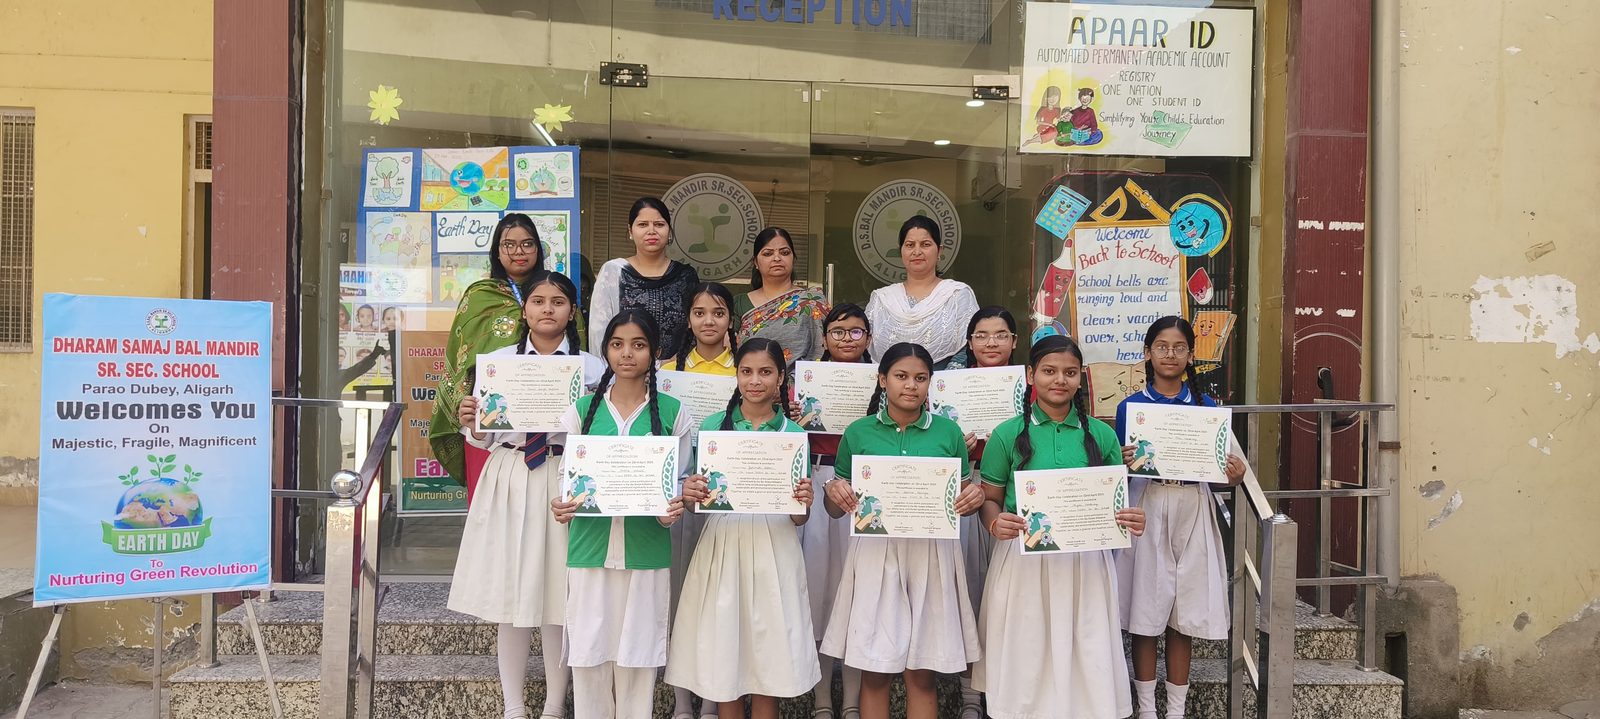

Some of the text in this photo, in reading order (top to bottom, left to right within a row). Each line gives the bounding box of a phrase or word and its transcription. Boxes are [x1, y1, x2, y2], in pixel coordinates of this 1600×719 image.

[712, 0, 912, 27] RECEPTION
[1068, 17, 1216, 48] APAAR ID
[1037, 48, 1231, 68] AUTOMATED PERMANENT ACADEMIC ACCOUNT
[1119, 70, 1156, 82] REGISTRY
[1103, 85, 1162, 96] ONE NATION
[1126, 97, 1201, 107] ONE STUDENT ID
[1099, 112, 1135, 127] Simplifying
[1189, 112, 1225, 126] Education
[1142, 128, 1177, 142] Journey
[670, 180, 708, 206] MANDIR
[869, 186, 907, 211] MANDIR
[438, 217, 494, 247] Earth Day
[1095, 227, 1153, 242] Welcome
[1078, 240, 1179, 270] Back to School
[874, 262, 907, 280] ALIG
[1078, 274, 1112, 287] School
[1116, 274, 1141, 287] bells
[1078, 291, 1168, 306] ringing loud and
[53, 337, 260, 357] DHARAM SAMAJ BAL MANDIR
[408, 348, 445, 357] DHARAM
[97, 362, 219, 378] SR. SEC. SCHOOL
[82, 383, 234, 398] Parao Dubey, Aligarh
[56, 401, 256, 420] Welcomes You
[149, 423, 170, 434] On
[52, 435, 257, 452] Majestic, Fragile, Magnificent
[411, 491, 453, 501] Nurturing
[117, 530, 200, 552] EARTH DAY
[150, 559, 163, 569] To
[49, 562, 258, 587] Nurturing Green Revolution
